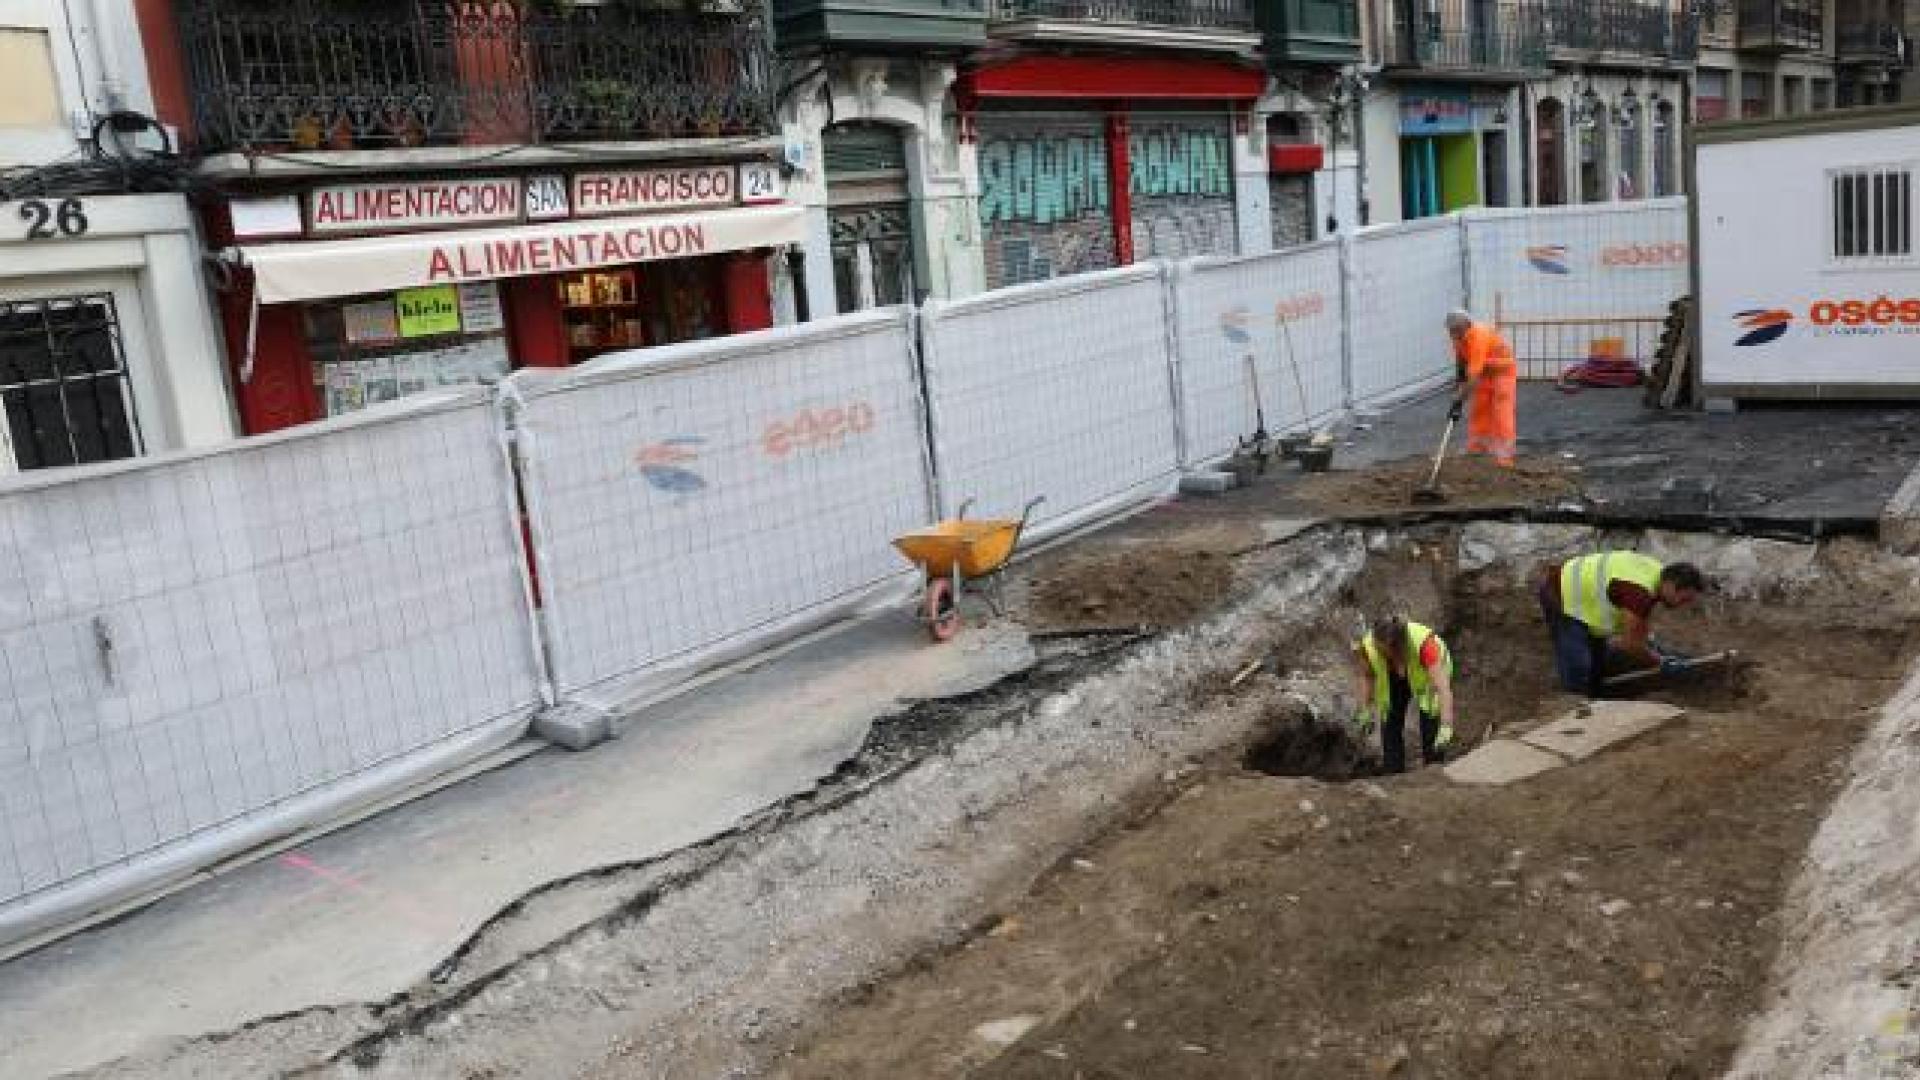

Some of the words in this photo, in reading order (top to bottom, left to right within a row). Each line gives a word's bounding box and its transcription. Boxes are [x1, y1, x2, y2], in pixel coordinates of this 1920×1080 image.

[20, 199, 88, 240] 26
[318, 183, 515, 223] ALIMENTACION
[528, 175, 567, 212] SAN
[580, 170, 729, 205] FRANCISCO
[748, 170, 772, 196] 24
[429, 224, 706, 280] ALIMENTACION
